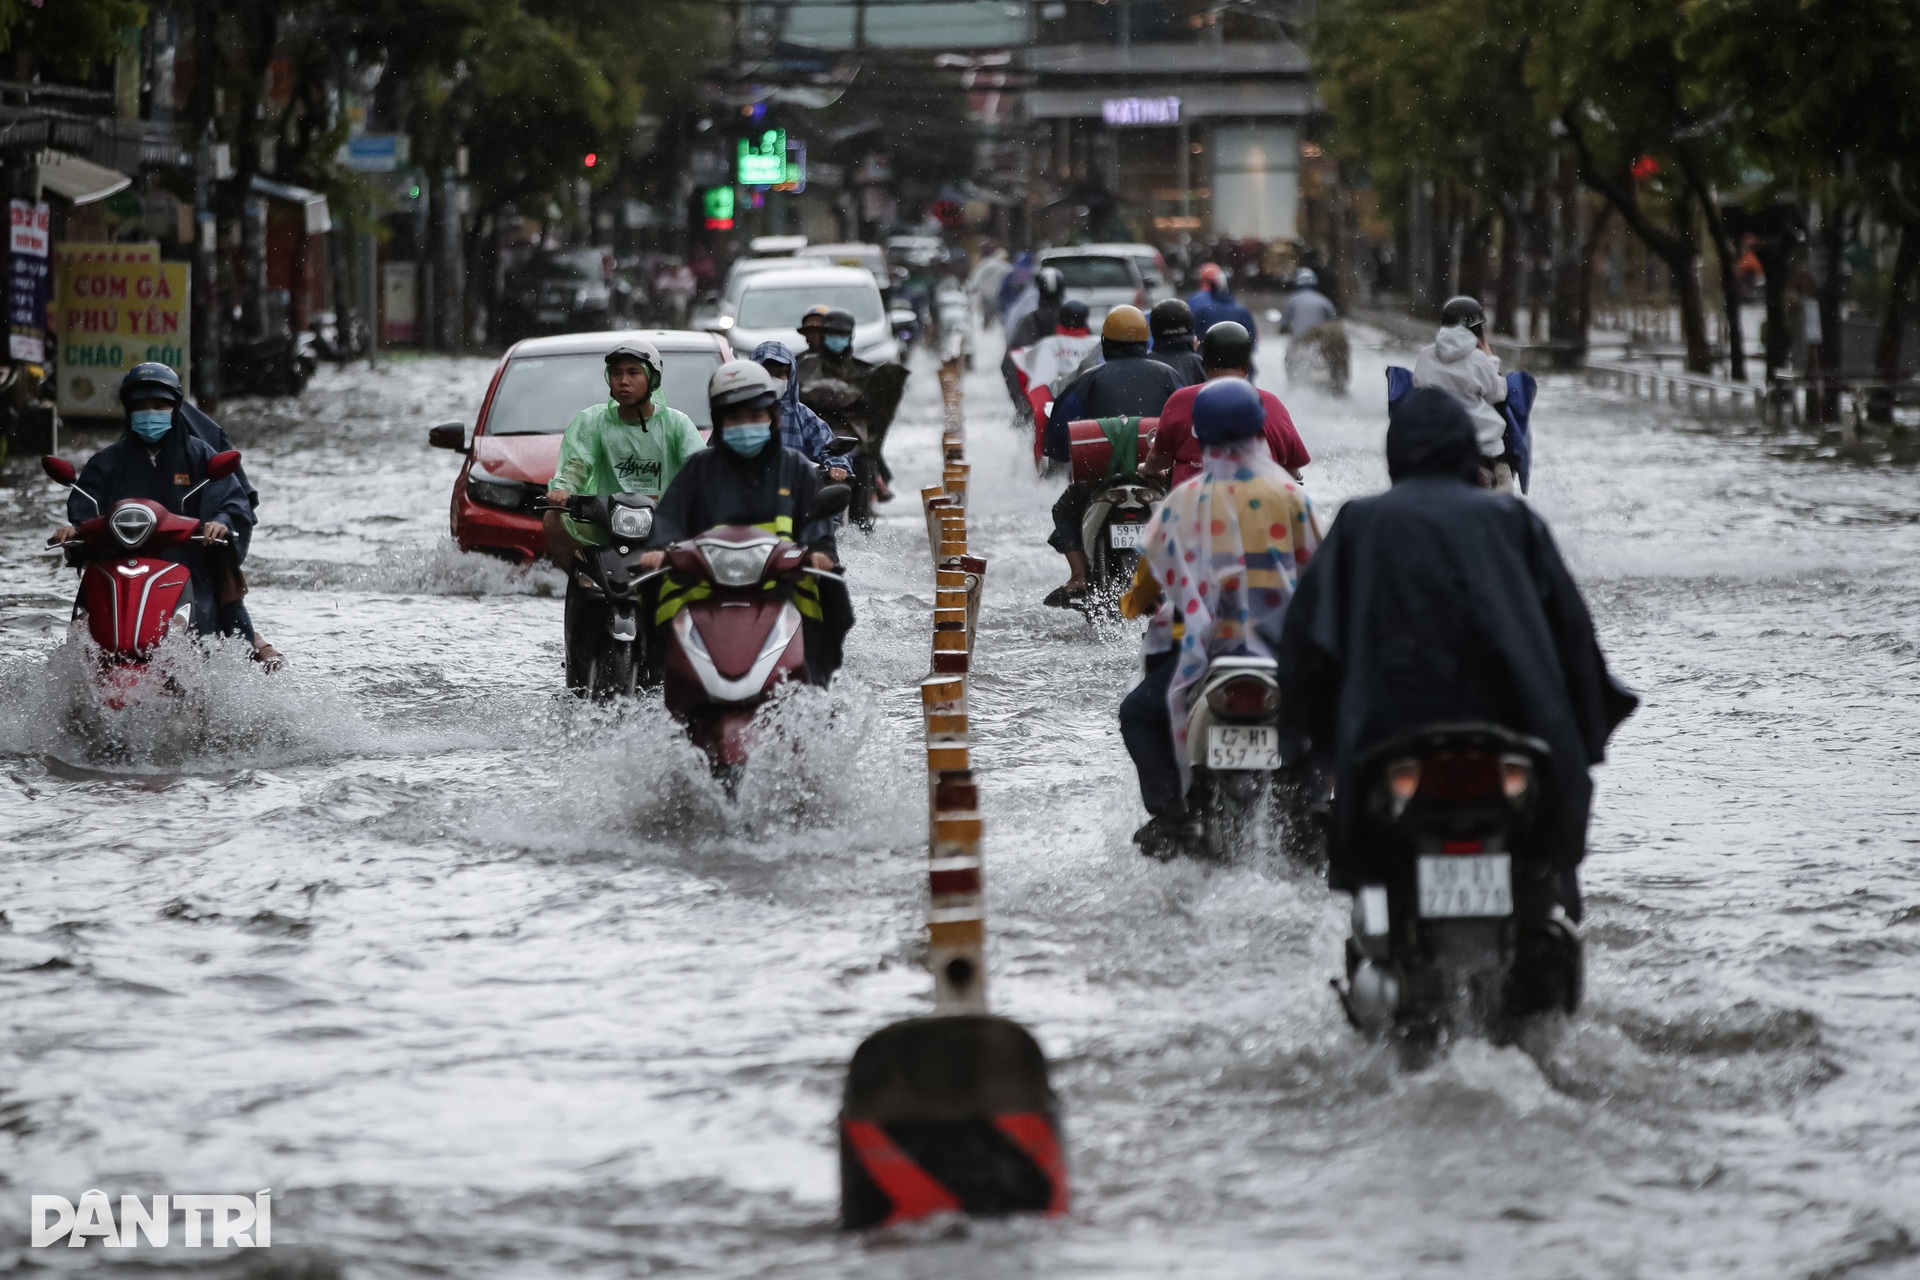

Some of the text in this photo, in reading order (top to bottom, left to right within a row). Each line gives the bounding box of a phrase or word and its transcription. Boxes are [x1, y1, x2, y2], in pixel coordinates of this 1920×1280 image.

[74, 269, 172, 300] CƠM GÀ
[67, 304, 119, 333] PHÚ
[128, 303, 179, 334] YÊN
[65, 341, 123, 367] CHÁO
[1113, 536, 1135, 547] 062
